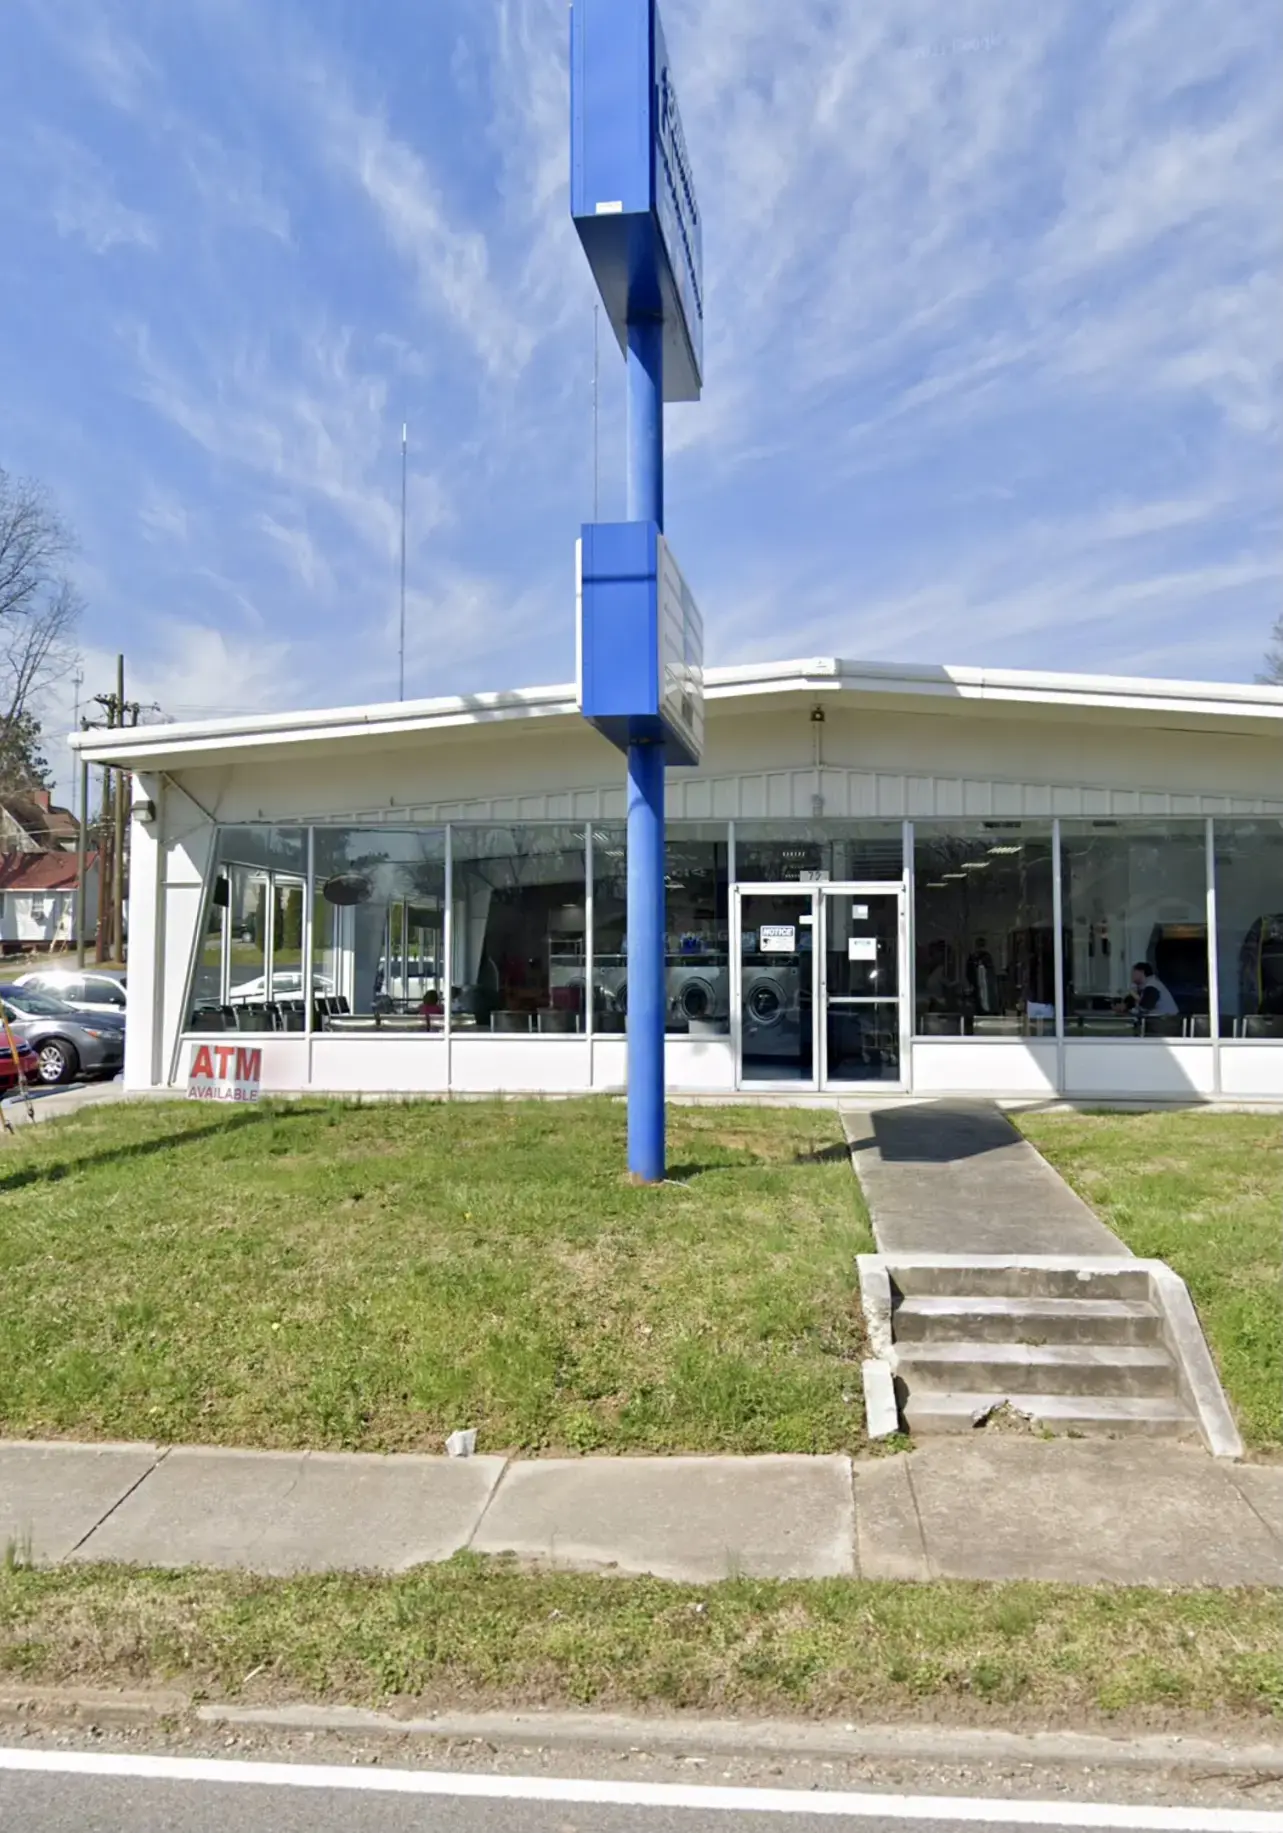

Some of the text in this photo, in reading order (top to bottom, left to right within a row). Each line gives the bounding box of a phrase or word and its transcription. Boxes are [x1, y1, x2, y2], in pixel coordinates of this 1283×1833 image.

[763, 928, 792, 936] NOTICE
[190, 1045, 261, 1081] ATM
[188, 1086, 257, 1101] AVAILABLE
